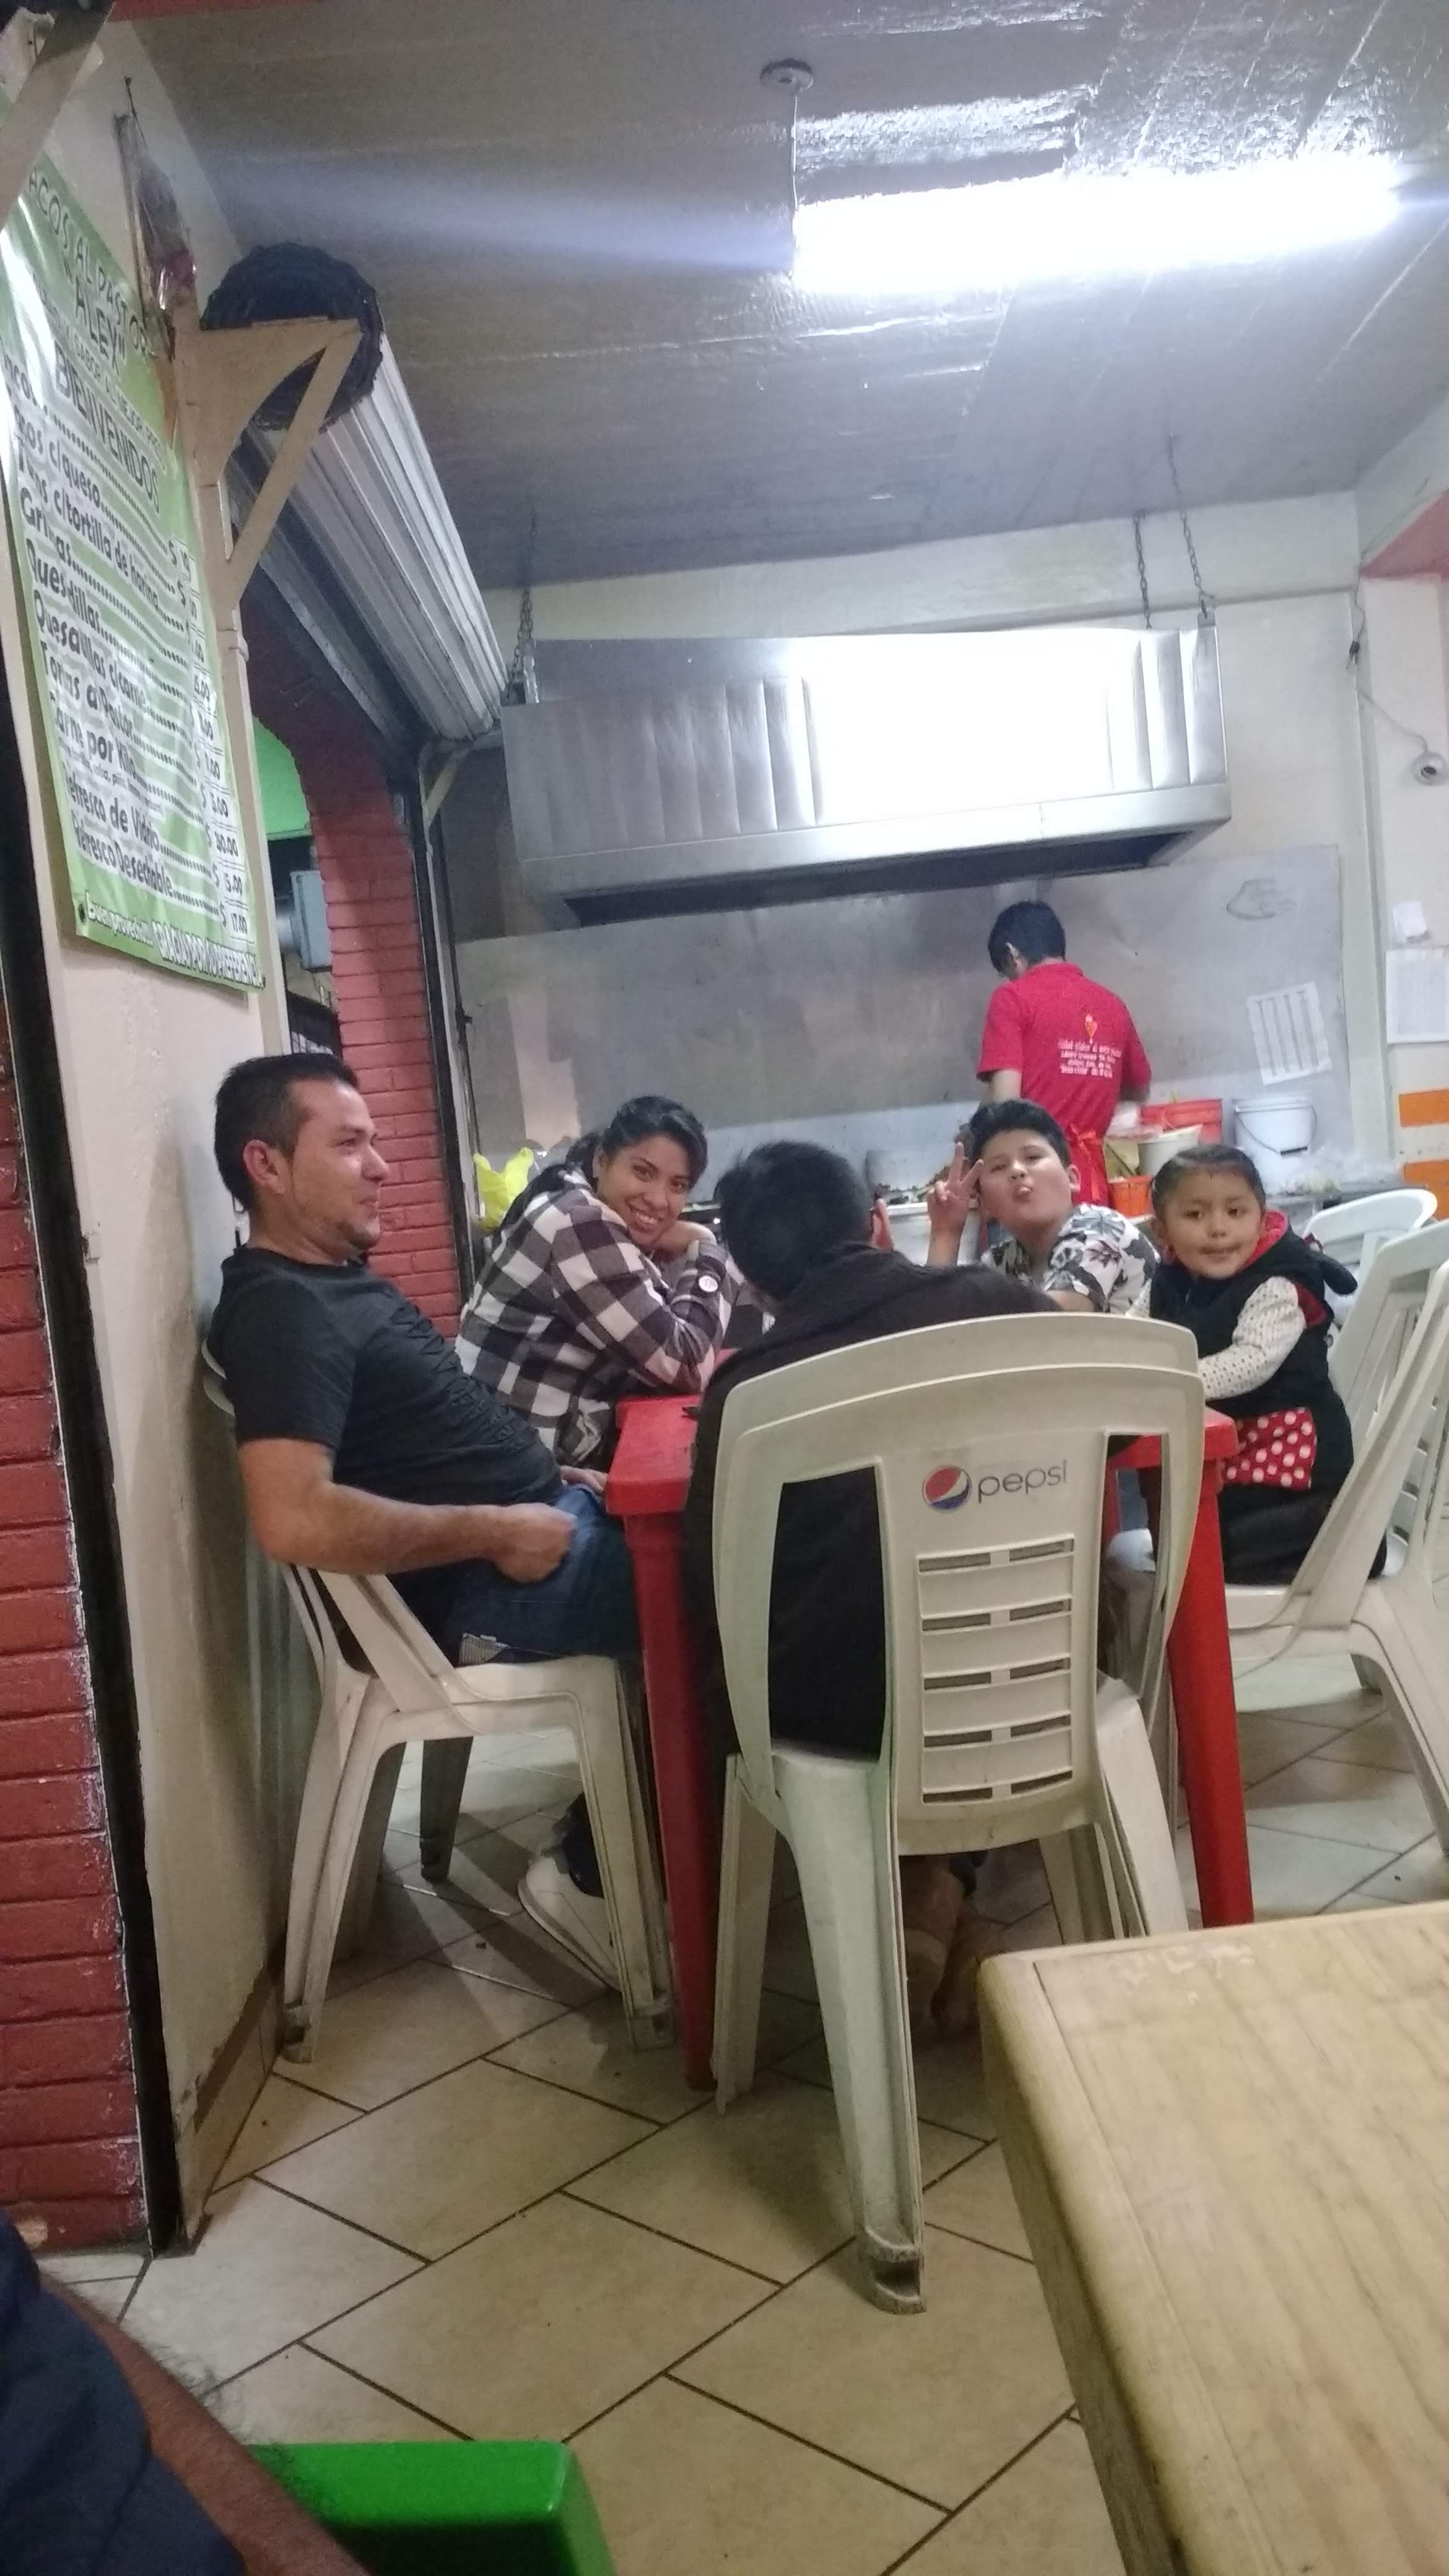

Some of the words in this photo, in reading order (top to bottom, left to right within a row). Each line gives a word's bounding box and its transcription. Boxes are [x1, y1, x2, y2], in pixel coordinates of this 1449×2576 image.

[76, 237, 93, 285] AL
[54, 340, 160, 513] BIENVENIDOS
[49, 440, 100, 509] c/queso
[54, 485, 112, 561] c/tortilla
[115, 539, 128, 577] de
[87, 730, 114, 764] por
[109, 797, 129, 834] de
[131, 805, 160, 852] Vidrio
[114, 840, 173, 898] Desechable
[978, 1460, 1068, 1503] pepsi
